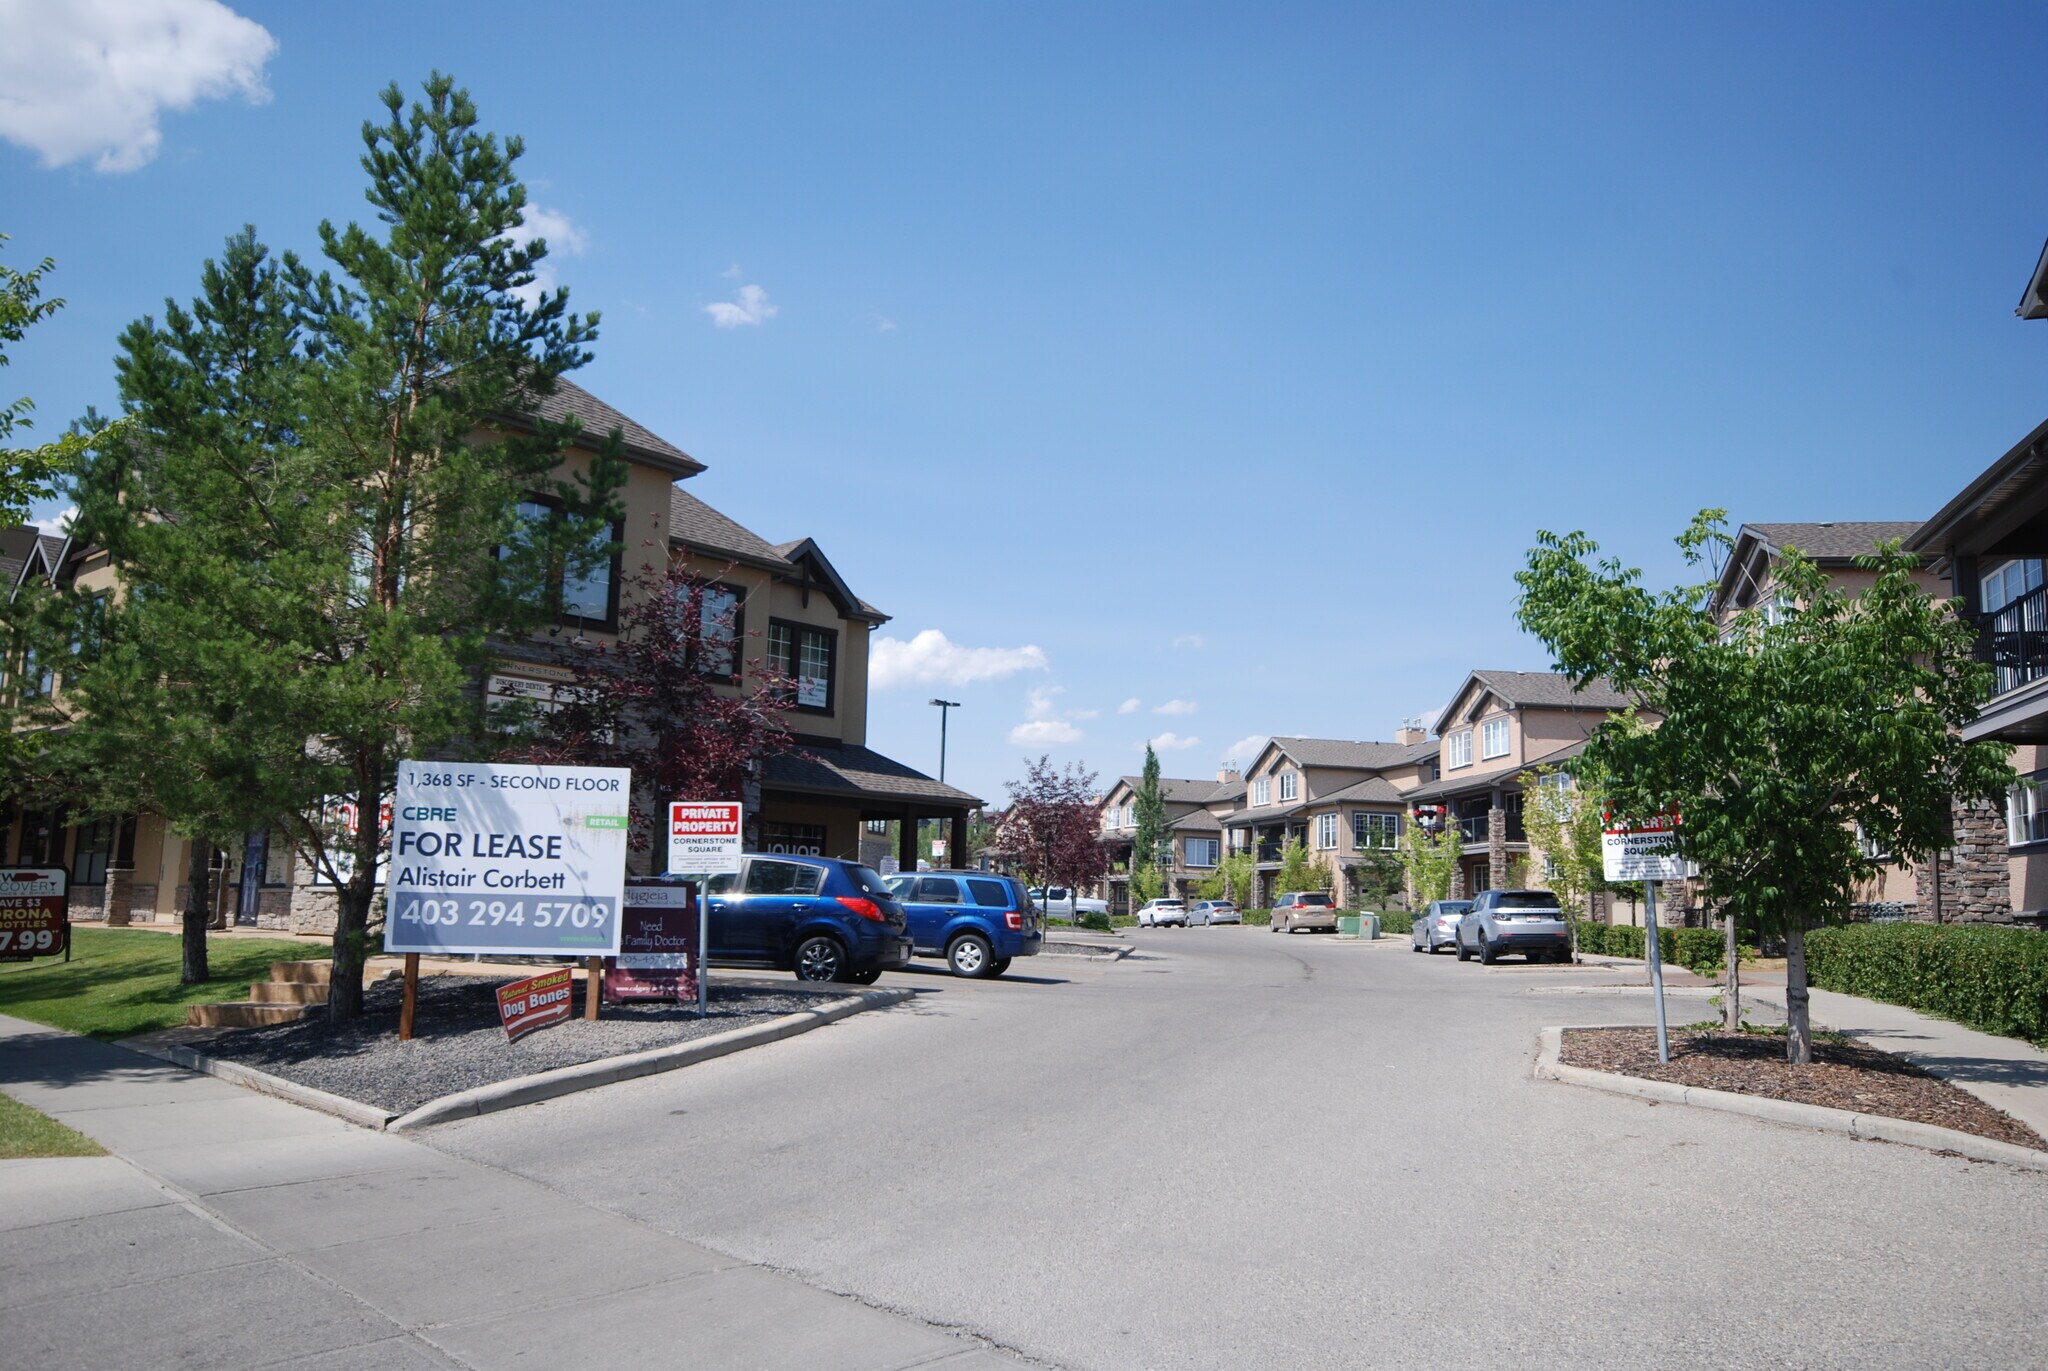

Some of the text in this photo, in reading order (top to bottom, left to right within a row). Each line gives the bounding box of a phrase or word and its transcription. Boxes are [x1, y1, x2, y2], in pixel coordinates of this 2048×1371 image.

[409, 773, 452, 788] 1,368
[457, 774, 475, 787] SF
[490, 775, 560, 790] SECOND
[566, 778, 619, 791] FLOOR
[402, 807, 457, 821] CBRE
[681, 808, 731, 819] PRIVATE
[590, 817, 619, 827] RETAIL
[674, 821, 737, 832] PROPERTY
[399, 832, 562, 859] FOR LEASE
[1607, 835, 1673, 846] CORNERSTON
[397, 866, 565, 888] Alistair Corbett
[27, 898, 41, 907] $3
[400, 899, 609, 928] 403 294 5709
[640, 917, 662, 931] Need
[625, 931, 652, 951] Family
[655, 934, 686, 946] Doctor
[501, 972, 569, 1000] Natural Smoked
[503, 987, 570, 1019] Dog Bones
